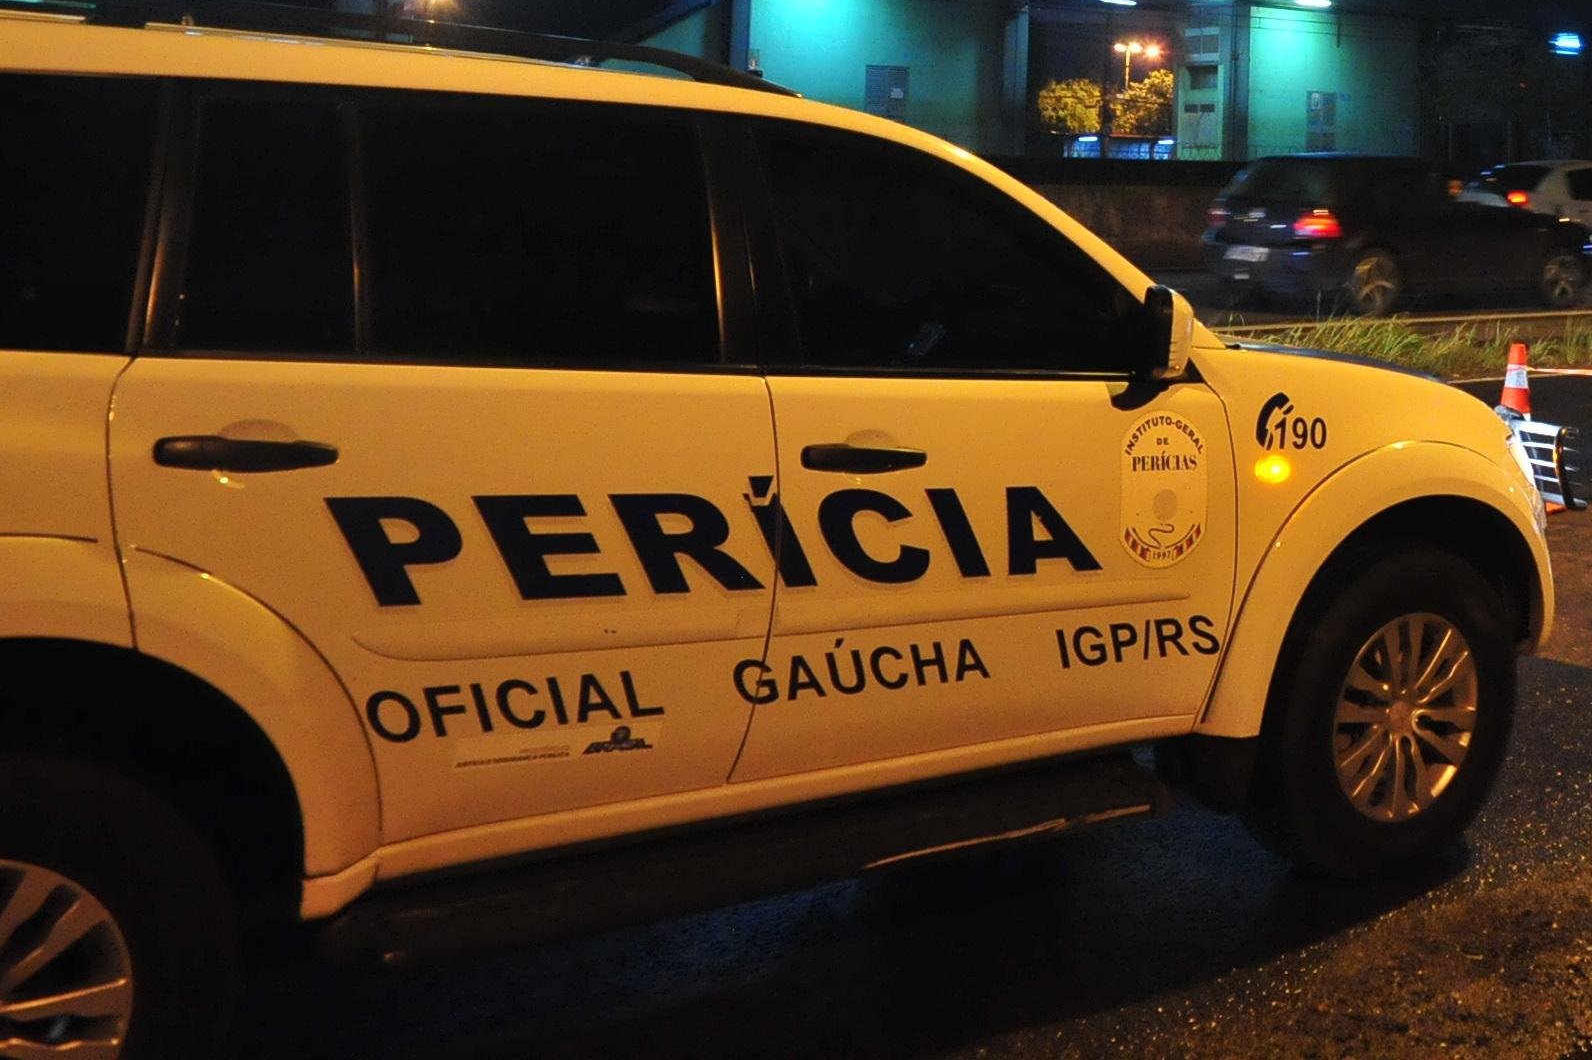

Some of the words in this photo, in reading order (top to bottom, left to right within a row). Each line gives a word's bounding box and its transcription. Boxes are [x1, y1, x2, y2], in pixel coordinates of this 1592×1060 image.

[1124, 415, 1204, 456] INSTITUTO-GERAL
[1156, 437, 1169, 446] DE
[1274, 417, 1327, 450] 190
[1132, 451, 1198, 472] PERÍCIAS
[324, 475, 1103, 608] PERÍCIA
[1152, 551, 1172, 560] 1997
[366, 669, 664, 743] OFICIAL
[733, 637, 990, 705] GAÚCHA
[1055, 614, 1220, 669] IGP/RS
